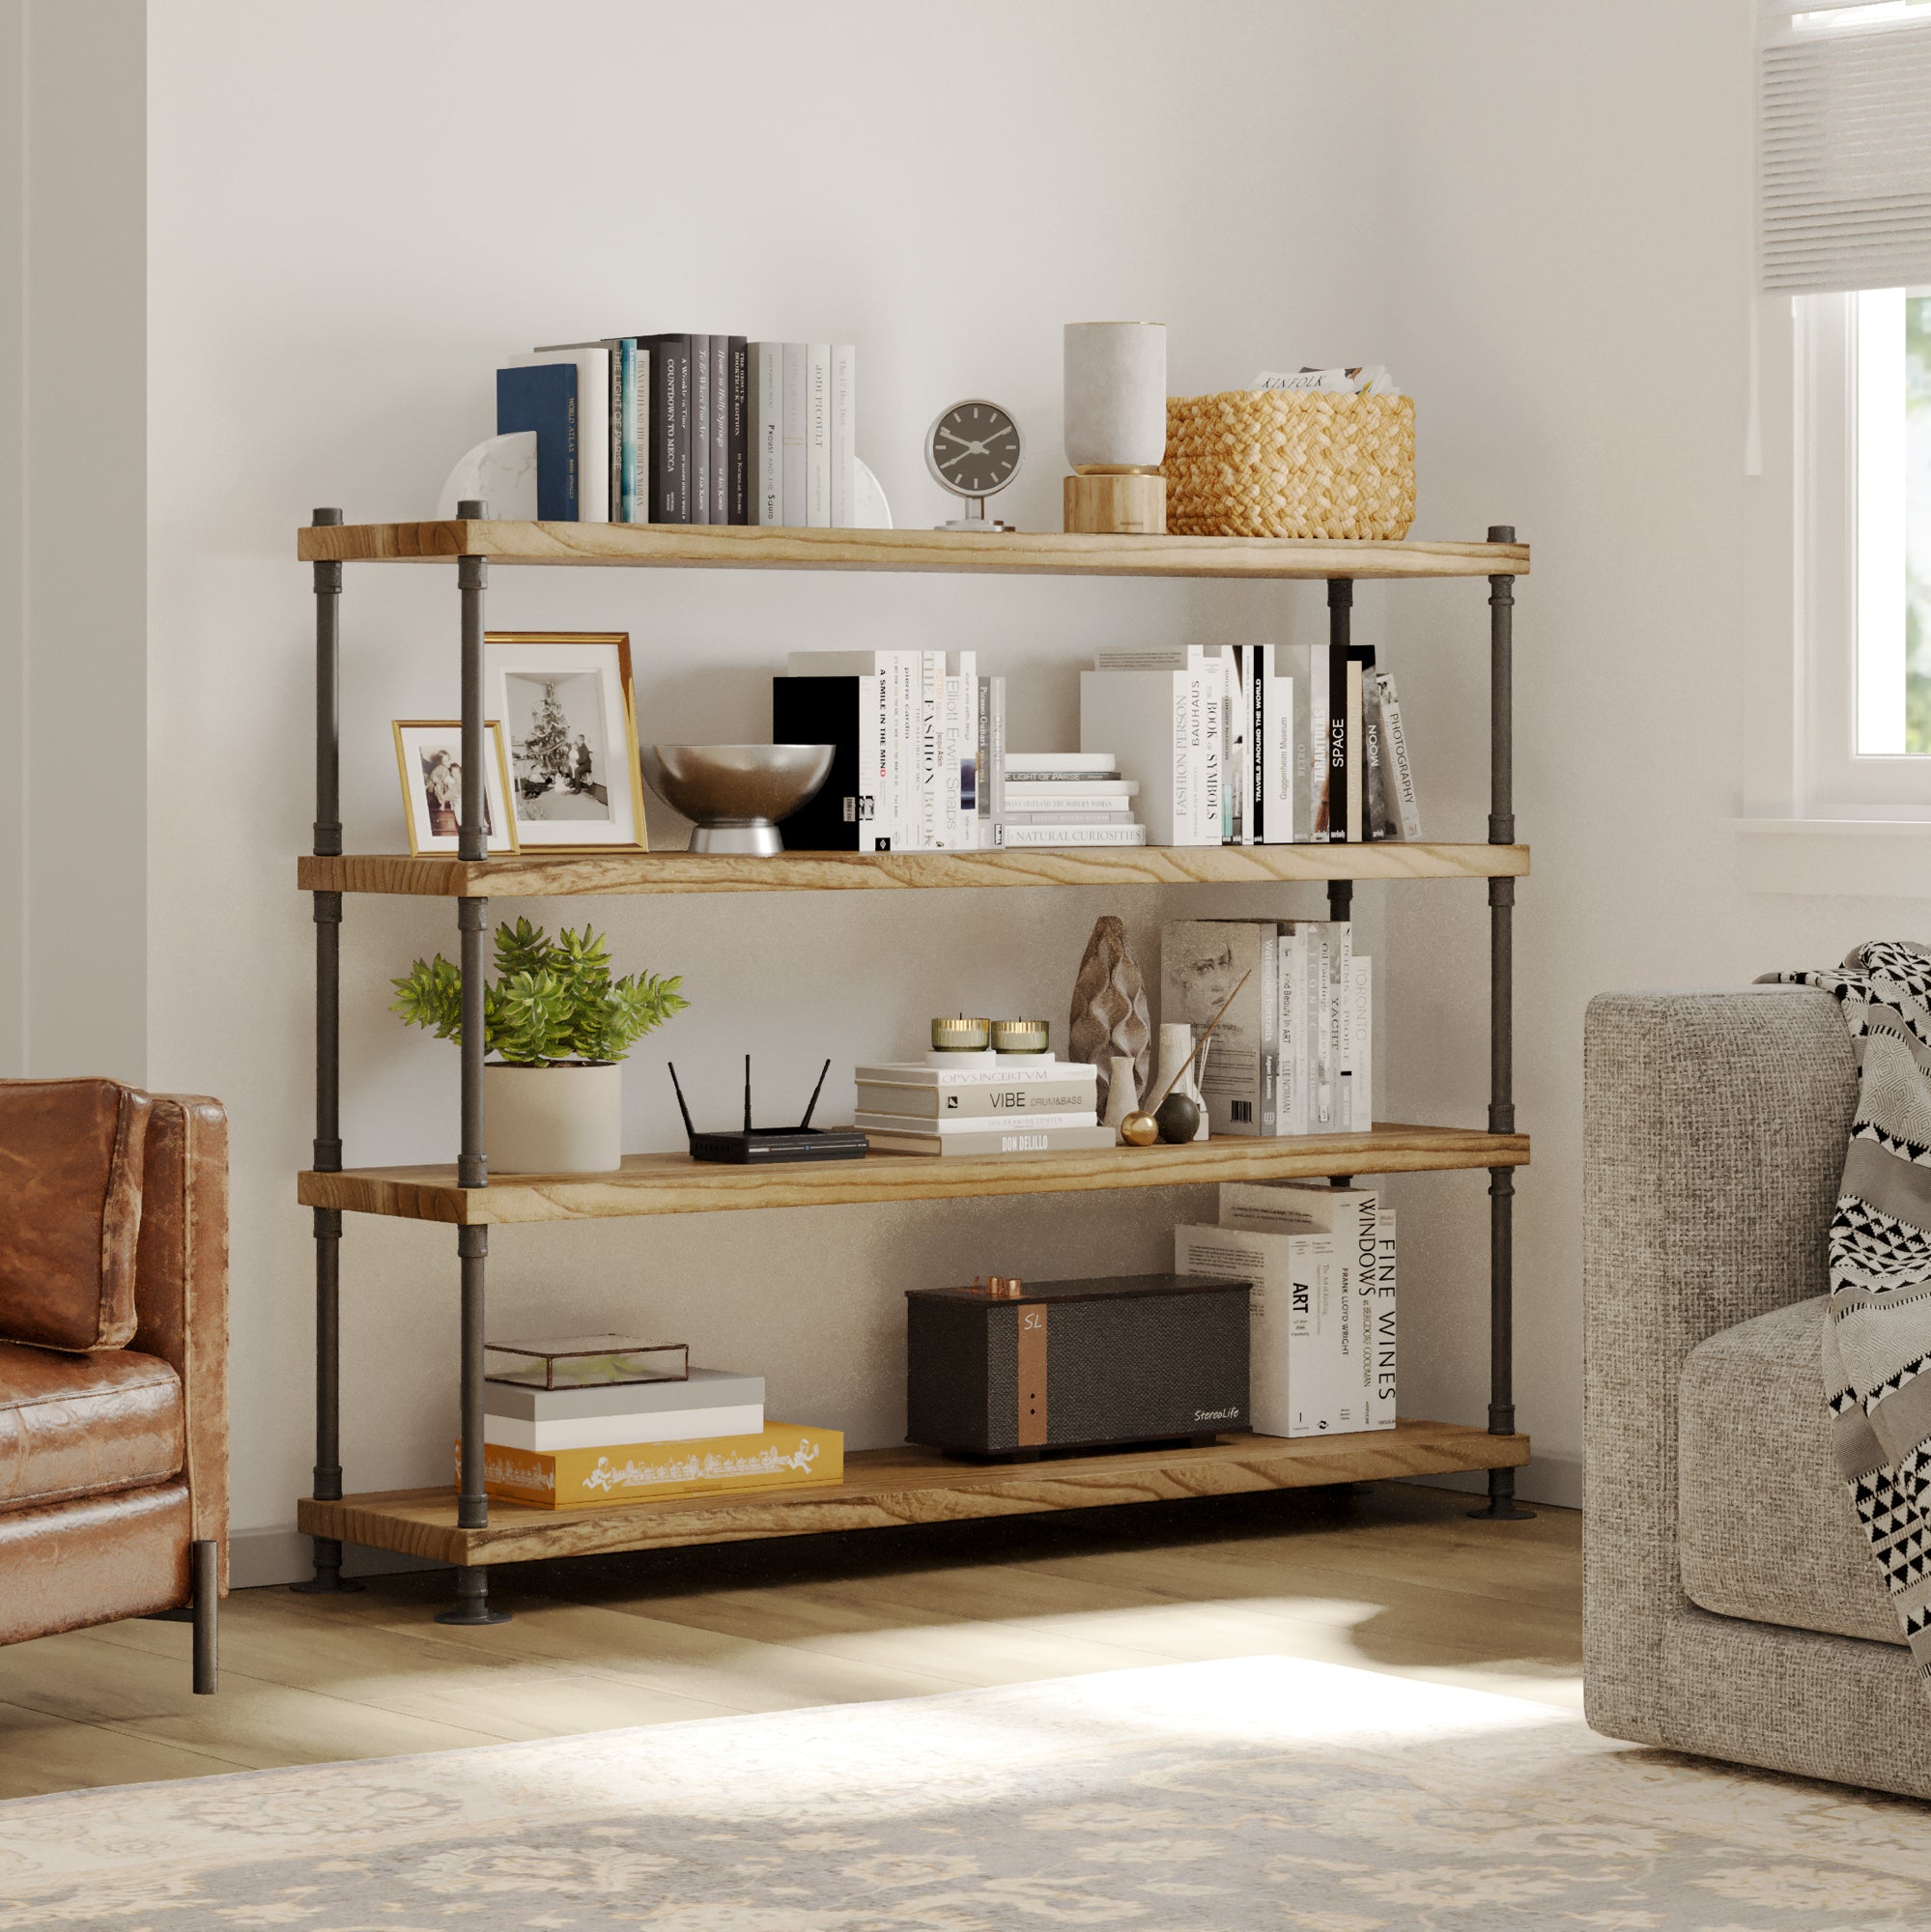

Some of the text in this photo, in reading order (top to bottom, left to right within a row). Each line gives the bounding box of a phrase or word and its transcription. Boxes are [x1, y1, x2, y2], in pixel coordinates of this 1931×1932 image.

[613, 350, 622, 371] THE
[698, 350, 706, 360] To
[698, 362, 706, 374] Be
[613, 374, 622, 407] LIGHT
[719, 378, 725, 386] to
[1262, 376, 1325, 388] KINFOLK
[717, 388, 725, 411] Holly
[814, 365, 823, 448] JODI PICOULT
[613, 411, 622, 428] OF
[667, 423, 674, 438] TO
[716, 415, 725, 448] Springs
[980, 686, 988, 715] Picasso
[1190, 680, 1200, 747] BAUHAUS
[880, 714, 886, 725] IN
[1207, 702, 1218, 739] BOOK
[924, 699, 934, 784] FASHION
[946, 680, 960, 831] Elliott Erwitt Snaps
[1175, 695, 1187, 816] FASHION PERSON
[1314, 709, 1326, 782] TARANTULAS
[1332, 718, 1344, 768] SPACE
[1368, 724, 1379, 767] MOON
[1297, 743, 1306, 777] RETRO
[1389, 713, 1414, 804] PHOTOGRAPHY
[1207, 753, 1218, 820] SYMBOLS
[1280, 751, 1289, 800] Guggenheim
[924, 791, 934, 847] BOOK
[1016, 829, 1143, 842] NATURAL CURIOSITIES
[1264, 939, 1275, 1041] Watercolor Portraits
[1283, 973, 1292, 989] Find
[1282, 990, 1292, 1017] Beauty
[1355, 966, 1368, 1041] TORONTO
[1283, 1029, 1292, 1044] ART
[1331, 997, 1340, 1051] YACHT
[942, 1068, 1049, 1084] OPVS INCERTVM
[1283, 1060, 1292, 1114] ELLE NORMAN
[989, 1092, 1083, 1108] VIBE DRUM&BASS
[1002, 1134, 1048, 1151] DON DELILLO
[1358, 1197, 1377, 1296] WINDOWS
[1292, 1282, 1309, 1314] ART
[1024, 1313, 1042, 1330] SL
[1378, 1239, 1396, 1400] FINE WINES
[1363, 1347, 1373, 1387] GOODMAN
[1194, 1406, 1239, 1422] StereoLife
